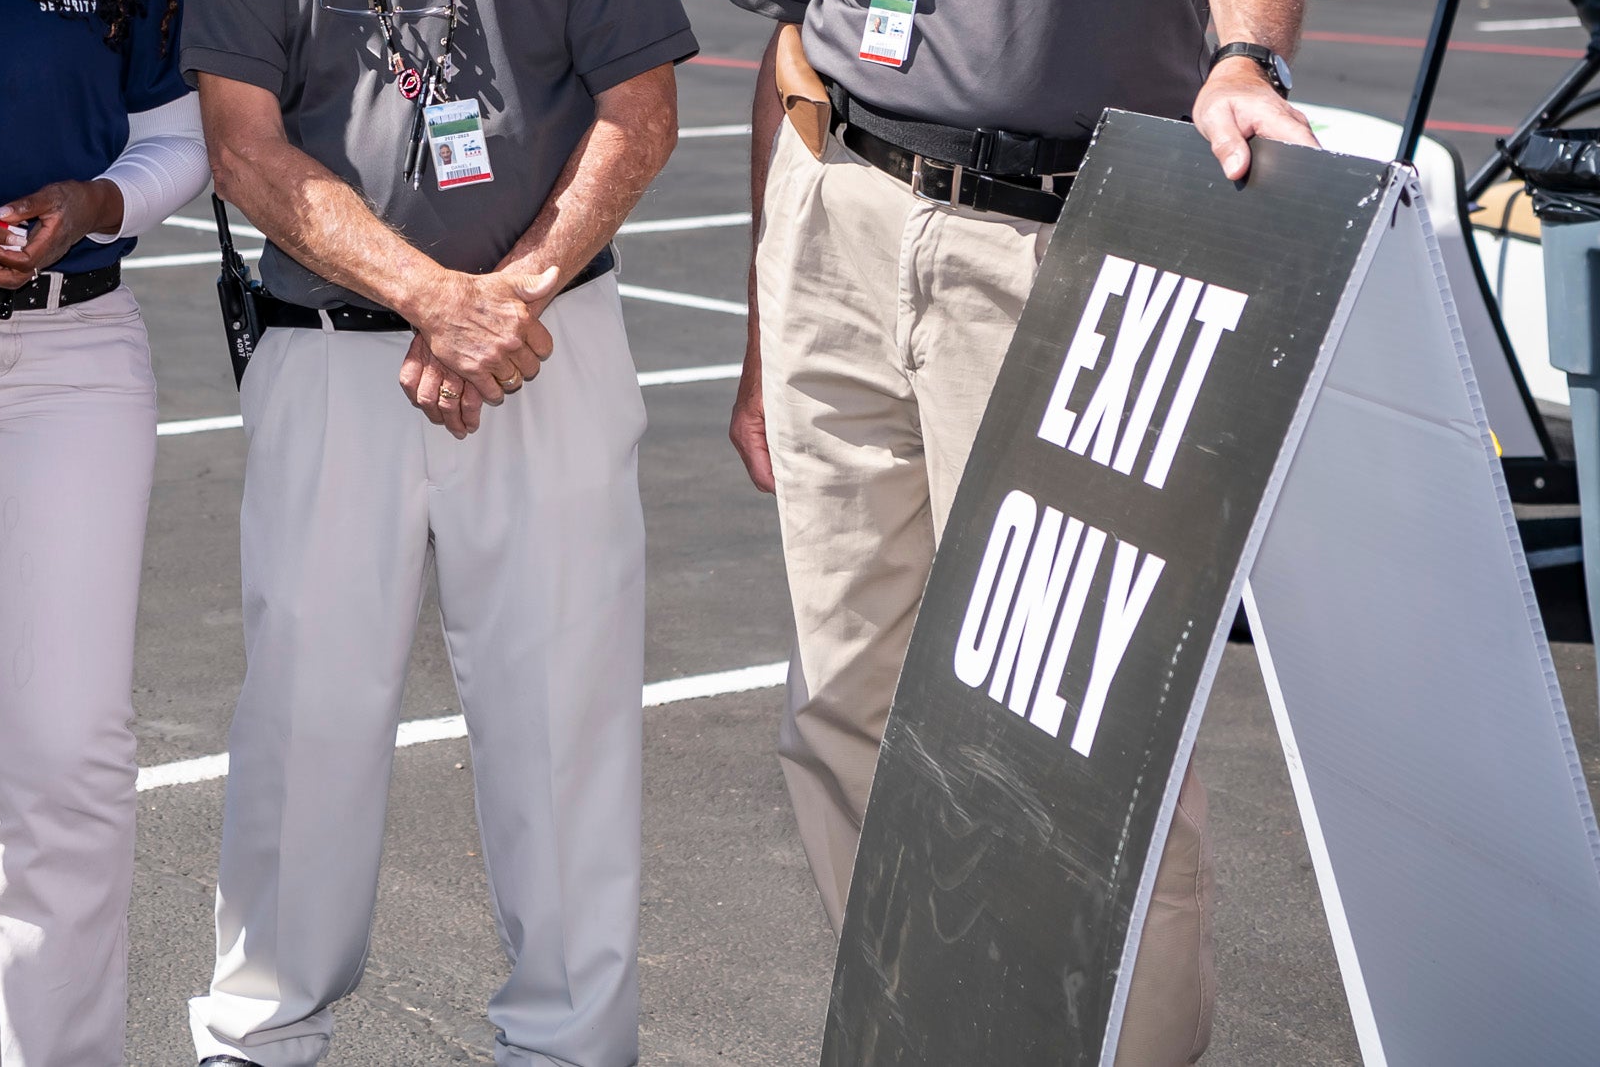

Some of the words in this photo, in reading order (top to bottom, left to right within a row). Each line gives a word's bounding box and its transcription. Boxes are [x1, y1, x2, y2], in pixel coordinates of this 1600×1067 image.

[39, 0, 97, 13] SEURITY
[236, 337, 246, 357] 4097
[1037, 254, 1249, 490] EXIT
[953, 489, 1166, 758] ONLY
